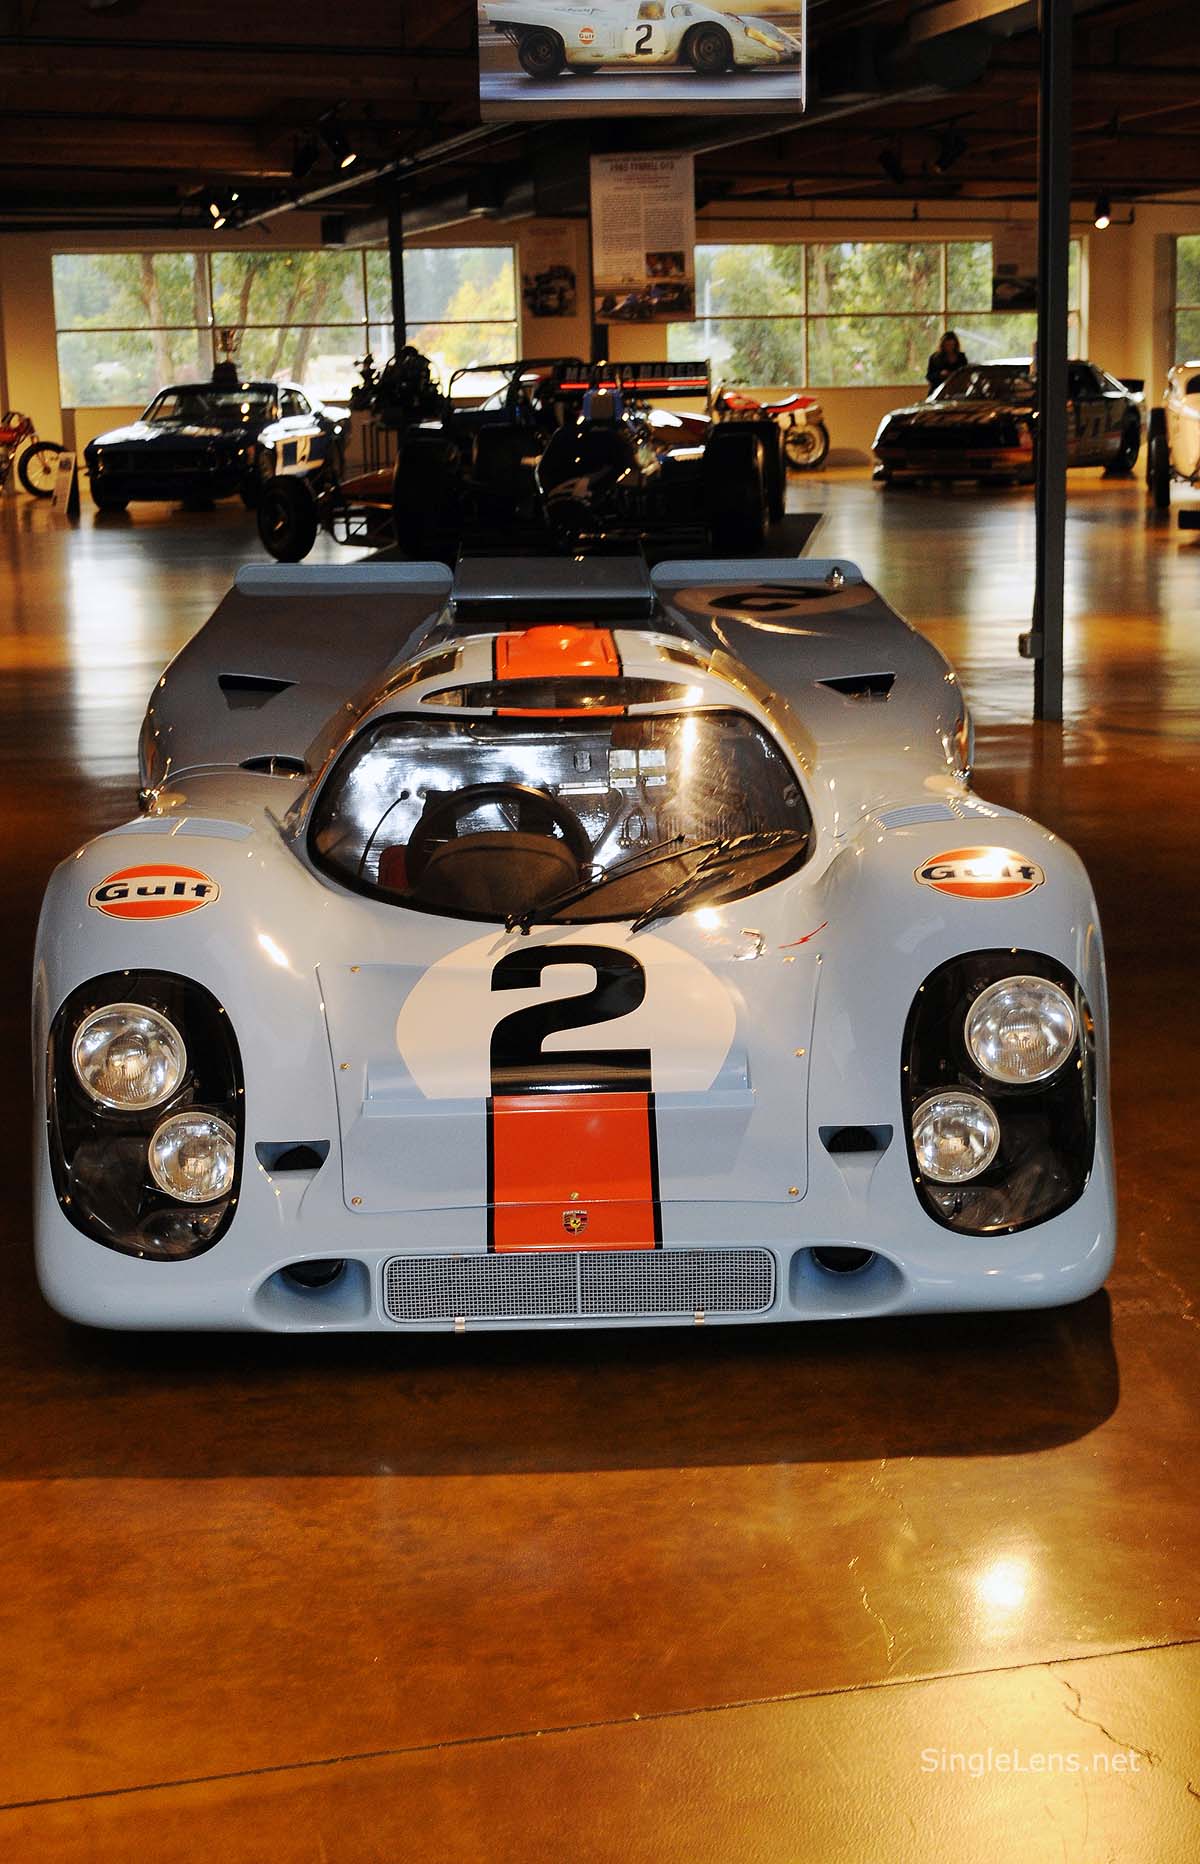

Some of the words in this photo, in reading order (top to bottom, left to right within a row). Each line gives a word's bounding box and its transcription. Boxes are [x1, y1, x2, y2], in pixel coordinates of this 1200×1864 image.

[635, 24, 653, 54] 2
[95, 881, 213, 902] Gulf
[490, 944, 652, 1096] 2
